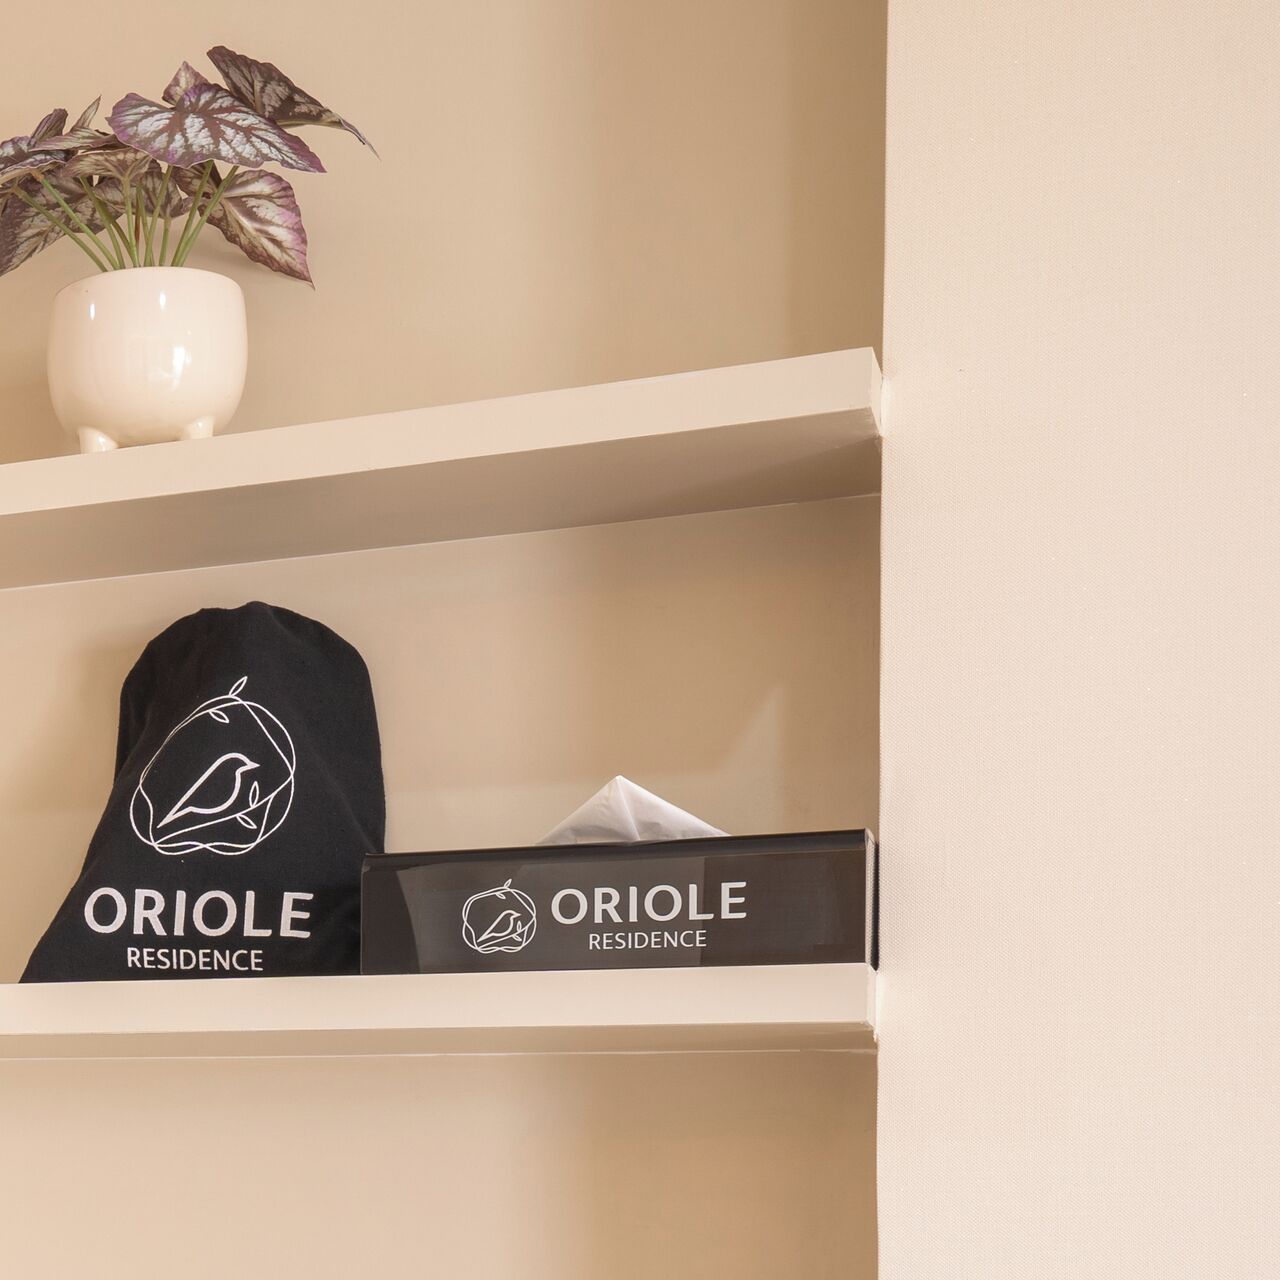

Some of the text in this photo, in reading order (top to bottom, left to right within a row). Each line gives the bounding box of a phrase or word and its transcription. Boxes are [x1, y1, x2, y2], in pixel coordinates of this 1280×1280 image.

[84, 887, 314, 938] ORIOLE
[551, 881, 747, 925] ORIOLE
[588, 930, 707, 950] RESIDENCE
[127, 947, 263, 971] RESIDENCE
